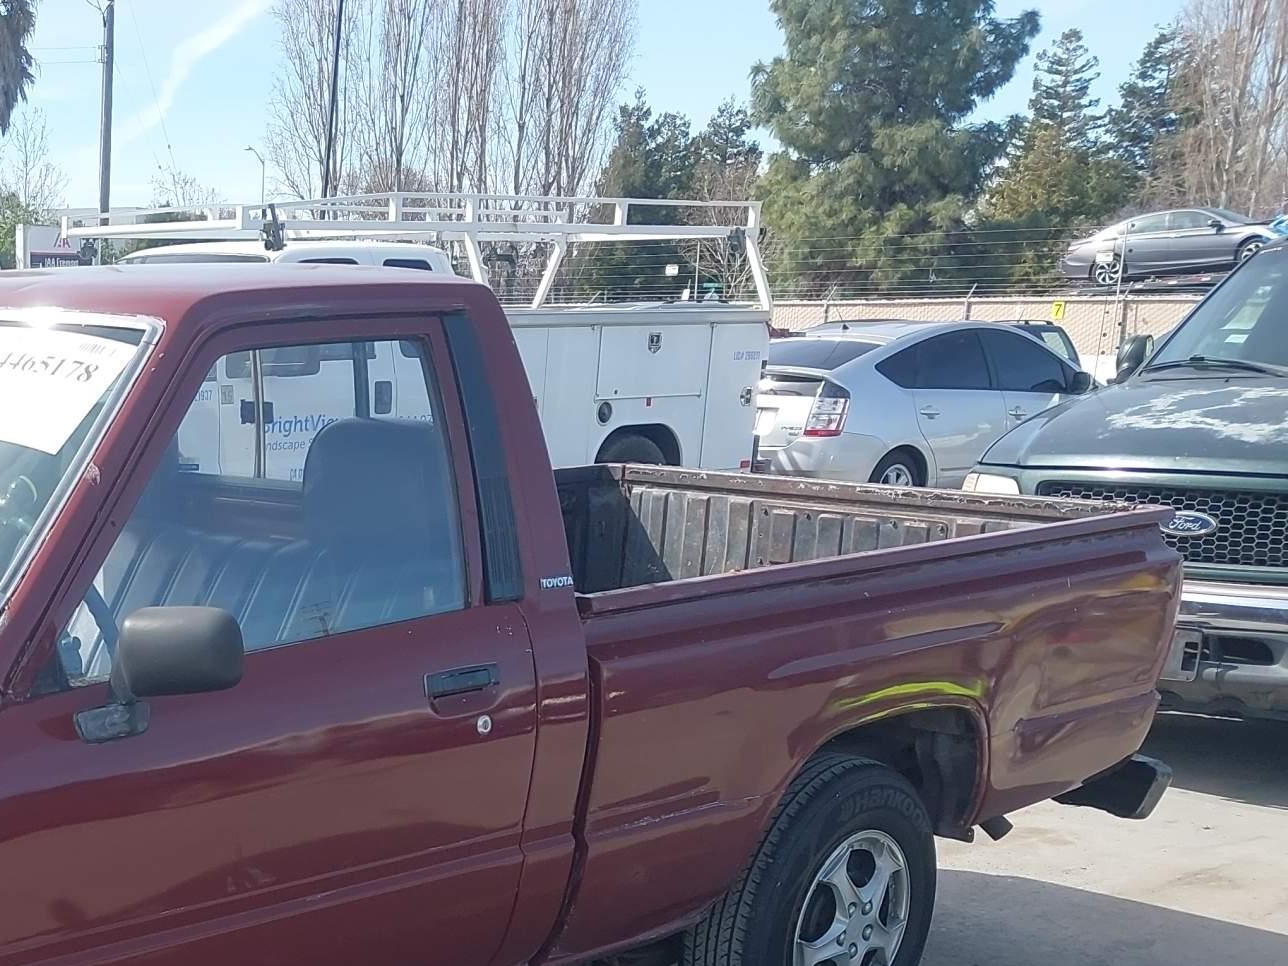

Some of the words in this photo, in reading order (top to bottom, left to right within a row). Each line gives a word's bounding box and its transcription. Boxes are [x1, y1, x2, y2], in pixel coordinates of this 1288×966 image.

[1054, 303, 1063, 317] 7
[1168, 516, 1202, 531] Ford
[542, 576, 574, 588] TOYOTA
